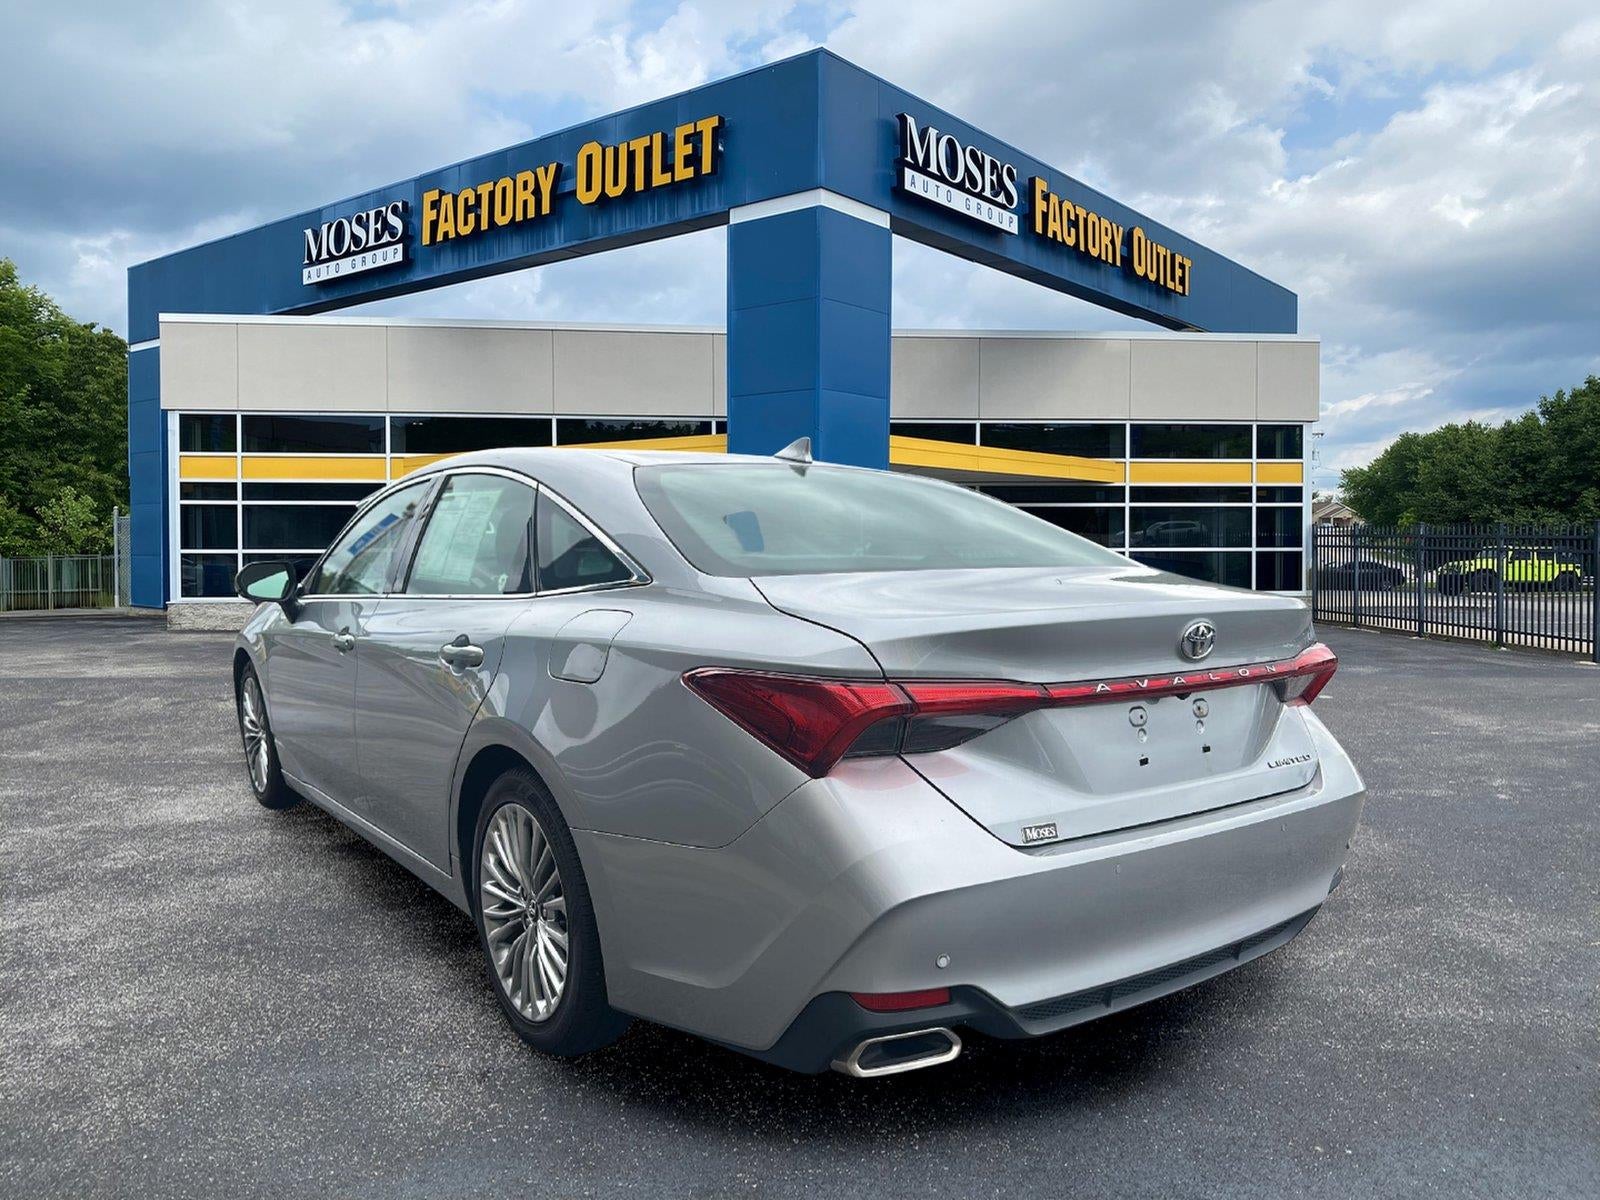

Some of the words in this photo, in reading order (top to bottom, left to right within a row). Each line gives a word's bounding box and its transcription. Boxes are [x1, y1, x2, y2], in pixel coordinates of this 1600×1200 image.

[422, 162, 560, 246] FACTORY
[576, 115, 721, 206] OUTLET
[904, 113, 1018, 209] MOSES
[910, 174, 952, 203] AUTO
[965, 198, 1014, 228] GROUP
[302, 201, 403, 265] MOSES
[1034, 177, 1124, 268] FACTORY
[1132, 226, 1193, 297] OUTLET
[307, 262, 340, 281] AUTO
[351, 247, 399, 270] GROUP
[1096, 665, 1276, 693] AVALON
[1267, 754, 1311, 769] LIMITED
[1024, 825, 1056, 841] MOSES
